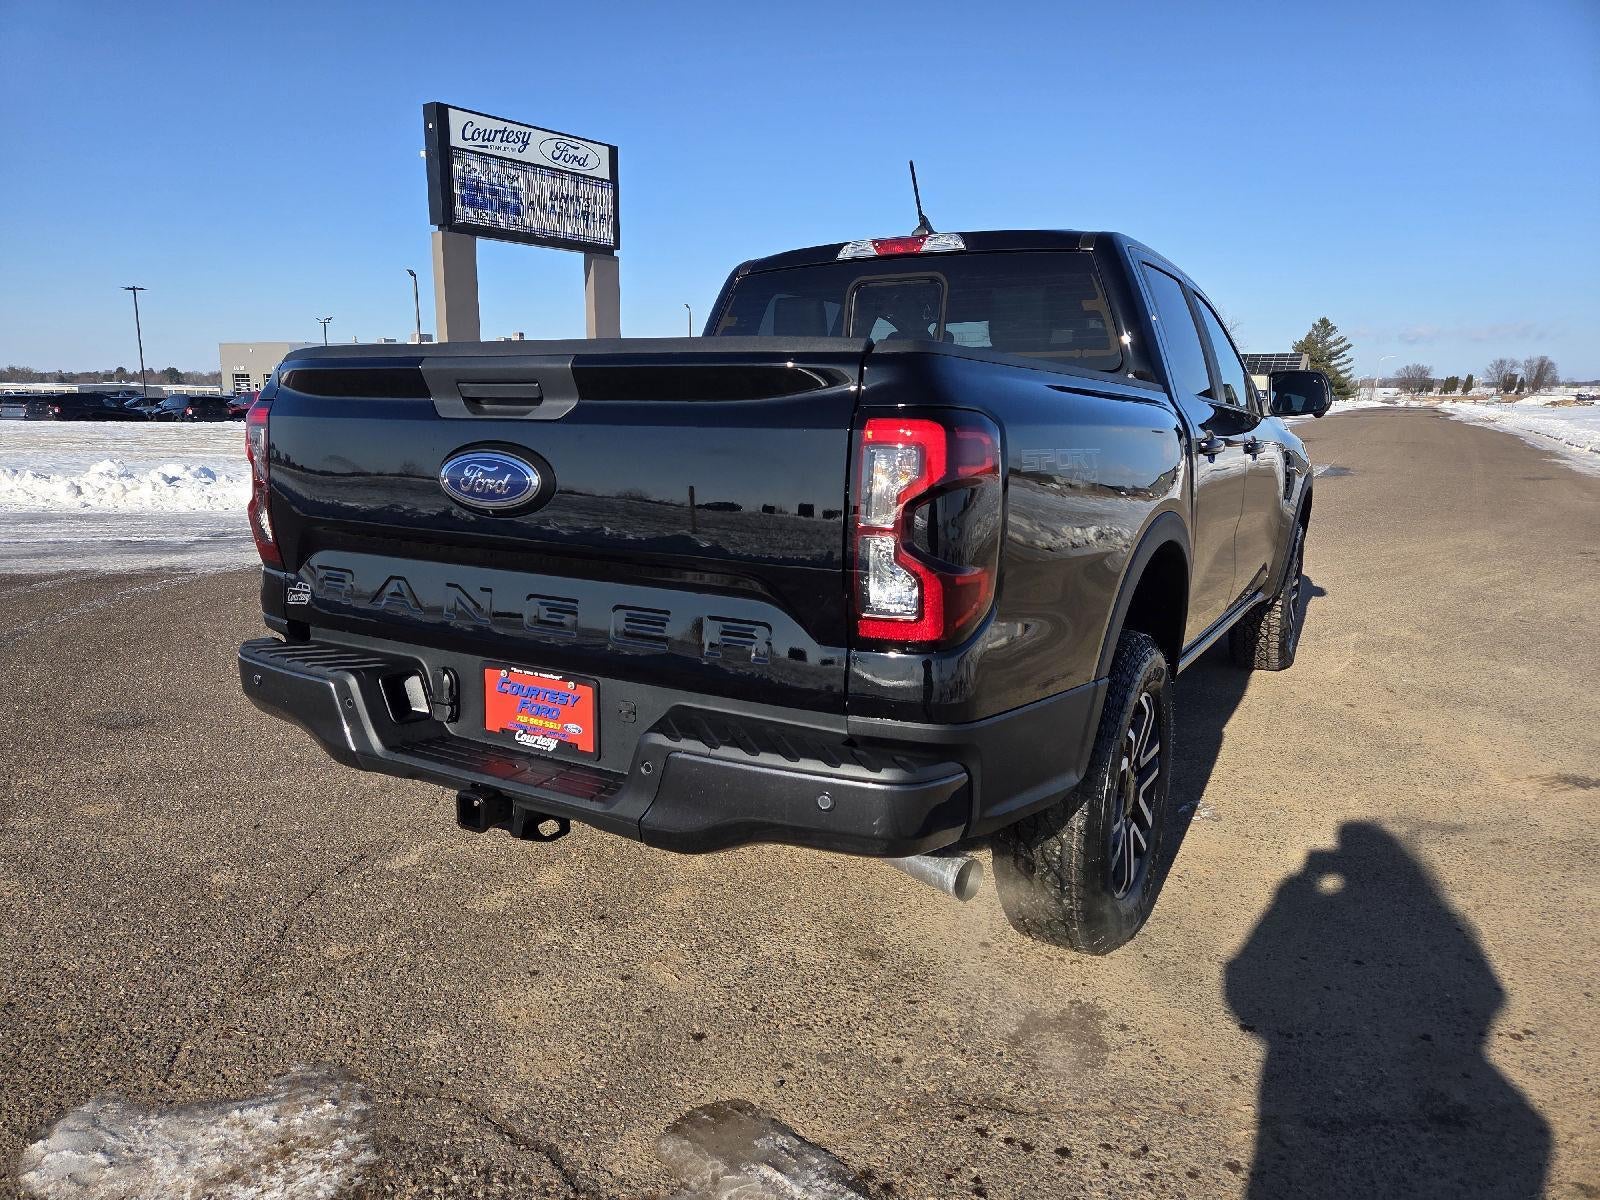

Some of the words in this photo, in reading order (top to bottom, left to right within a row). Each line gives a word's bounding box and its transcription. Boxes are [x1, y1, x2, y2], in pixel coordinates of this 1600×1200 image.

[461, 120, 532, 153] Courtesy
[551, 141, 589, 167] Ford
[1021, 448, 1100, 472] SPORT
[460, 463, 511, 495] Ford
[316, 565, 773, 664] RANGER
[497, 677, 580, 707] COURTESY
[517, 698, 560, 720] FORD
[514, 729, 559, 752] Courtesy
